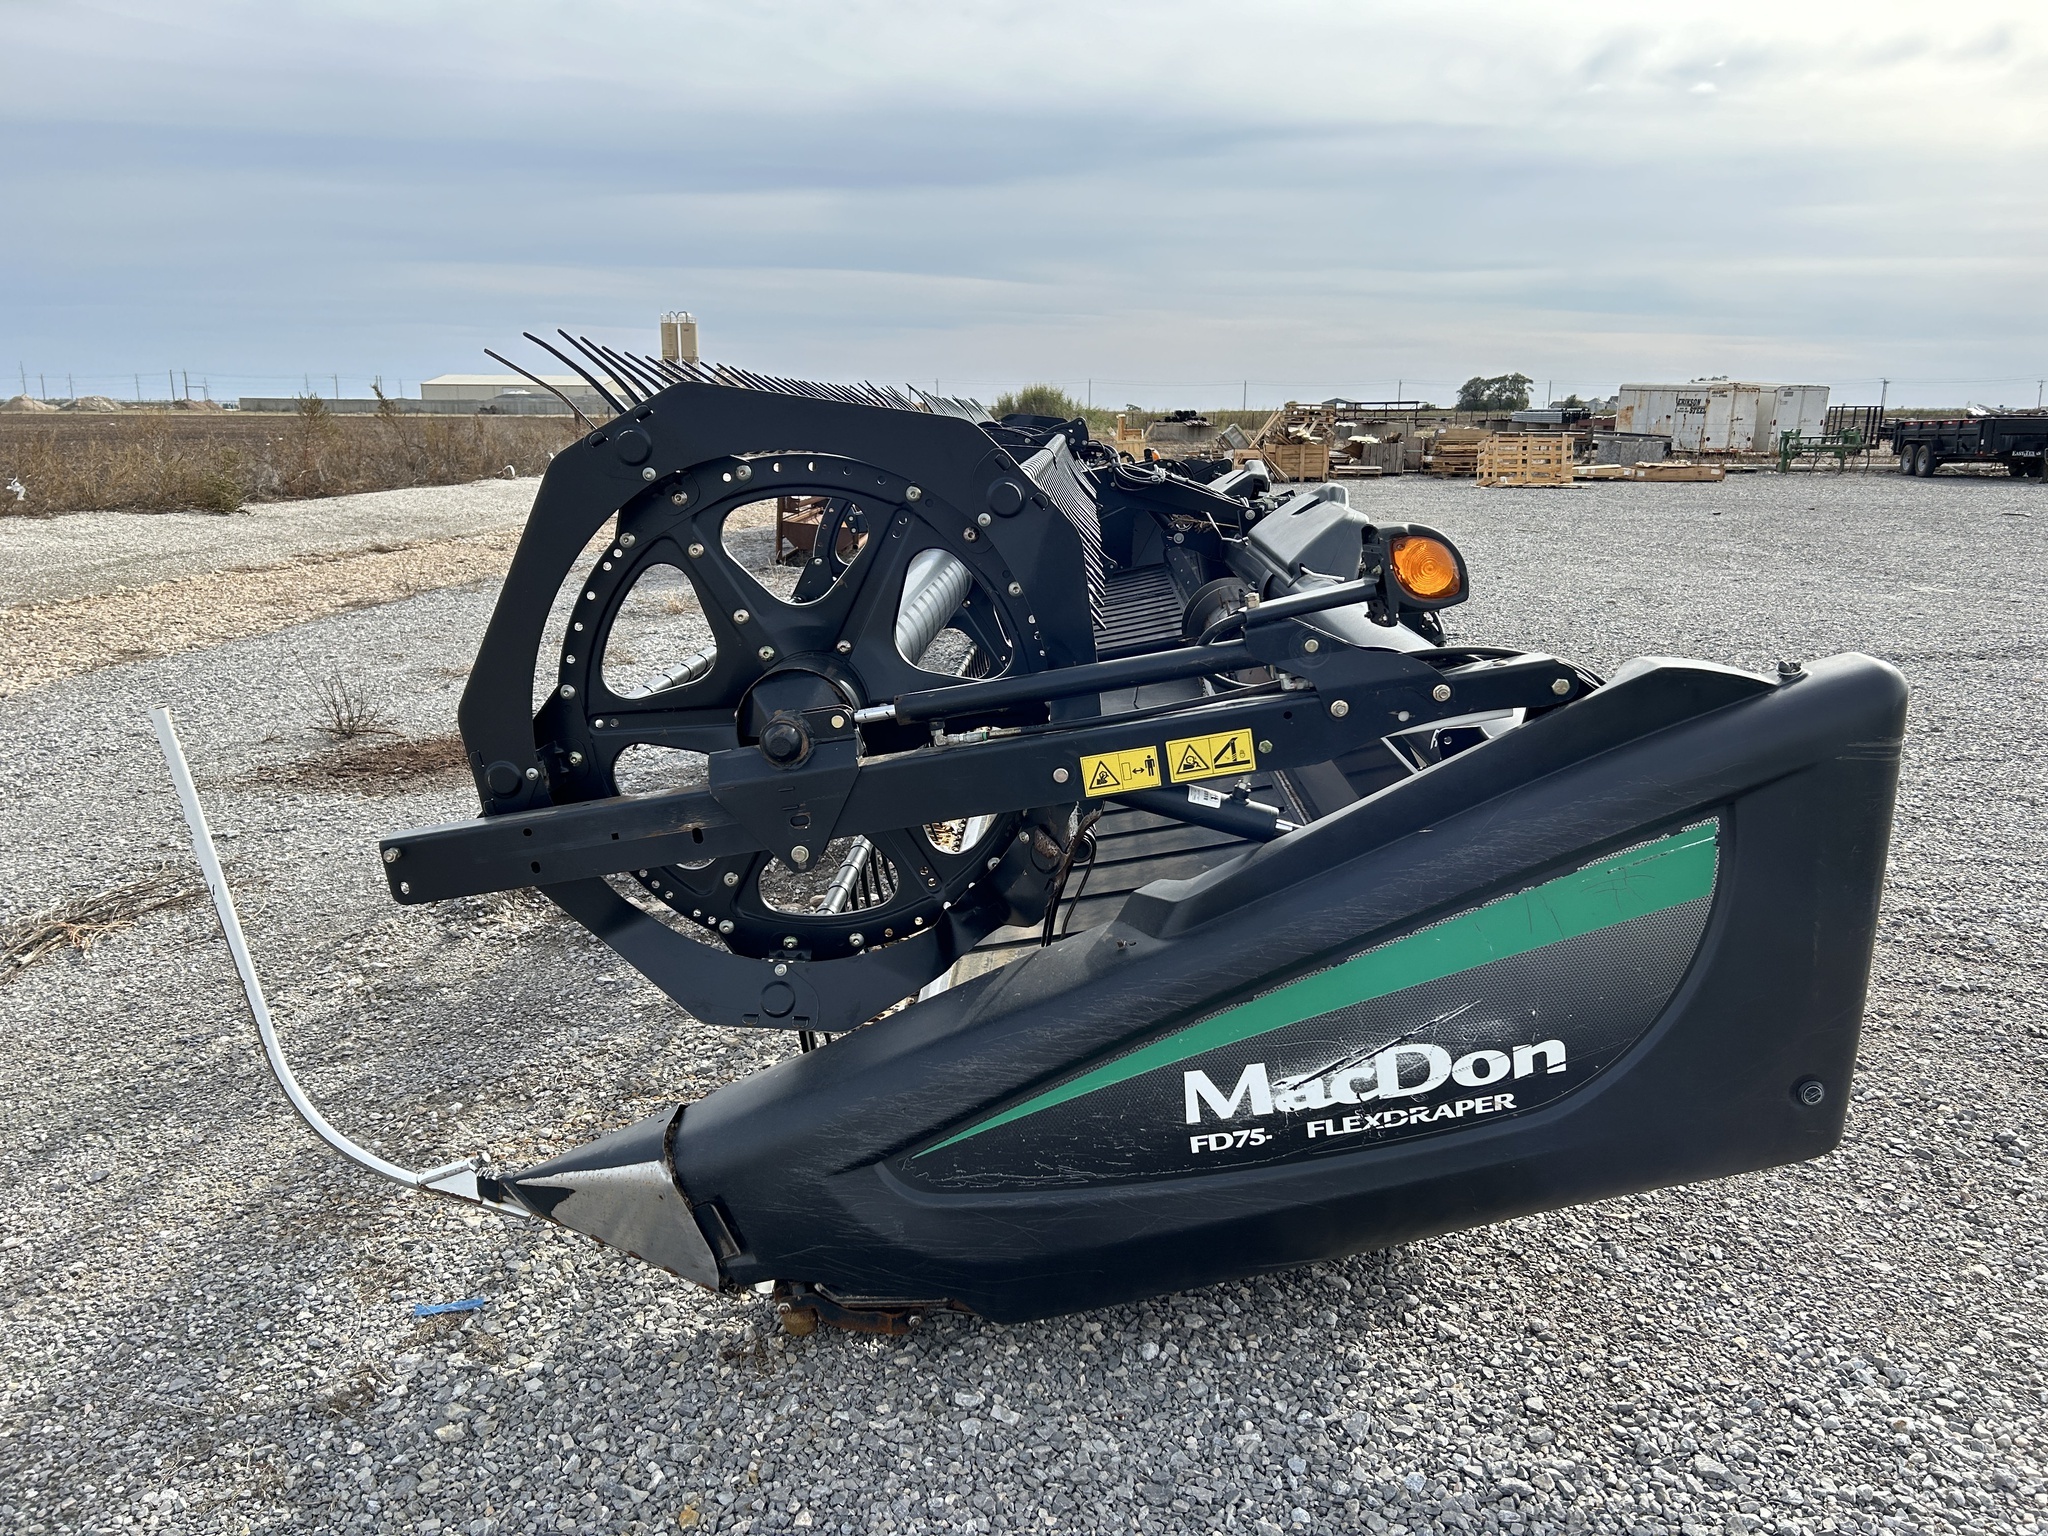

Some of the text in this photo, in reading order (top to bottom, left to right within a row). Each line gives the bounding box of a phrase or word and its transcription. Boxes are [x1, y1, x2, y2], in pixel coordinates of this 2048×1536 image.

[1184, 1040, 1566, 1124] MacDon
[1190, 1093, 1517, 1153] FD75- FLEXDRAPER
